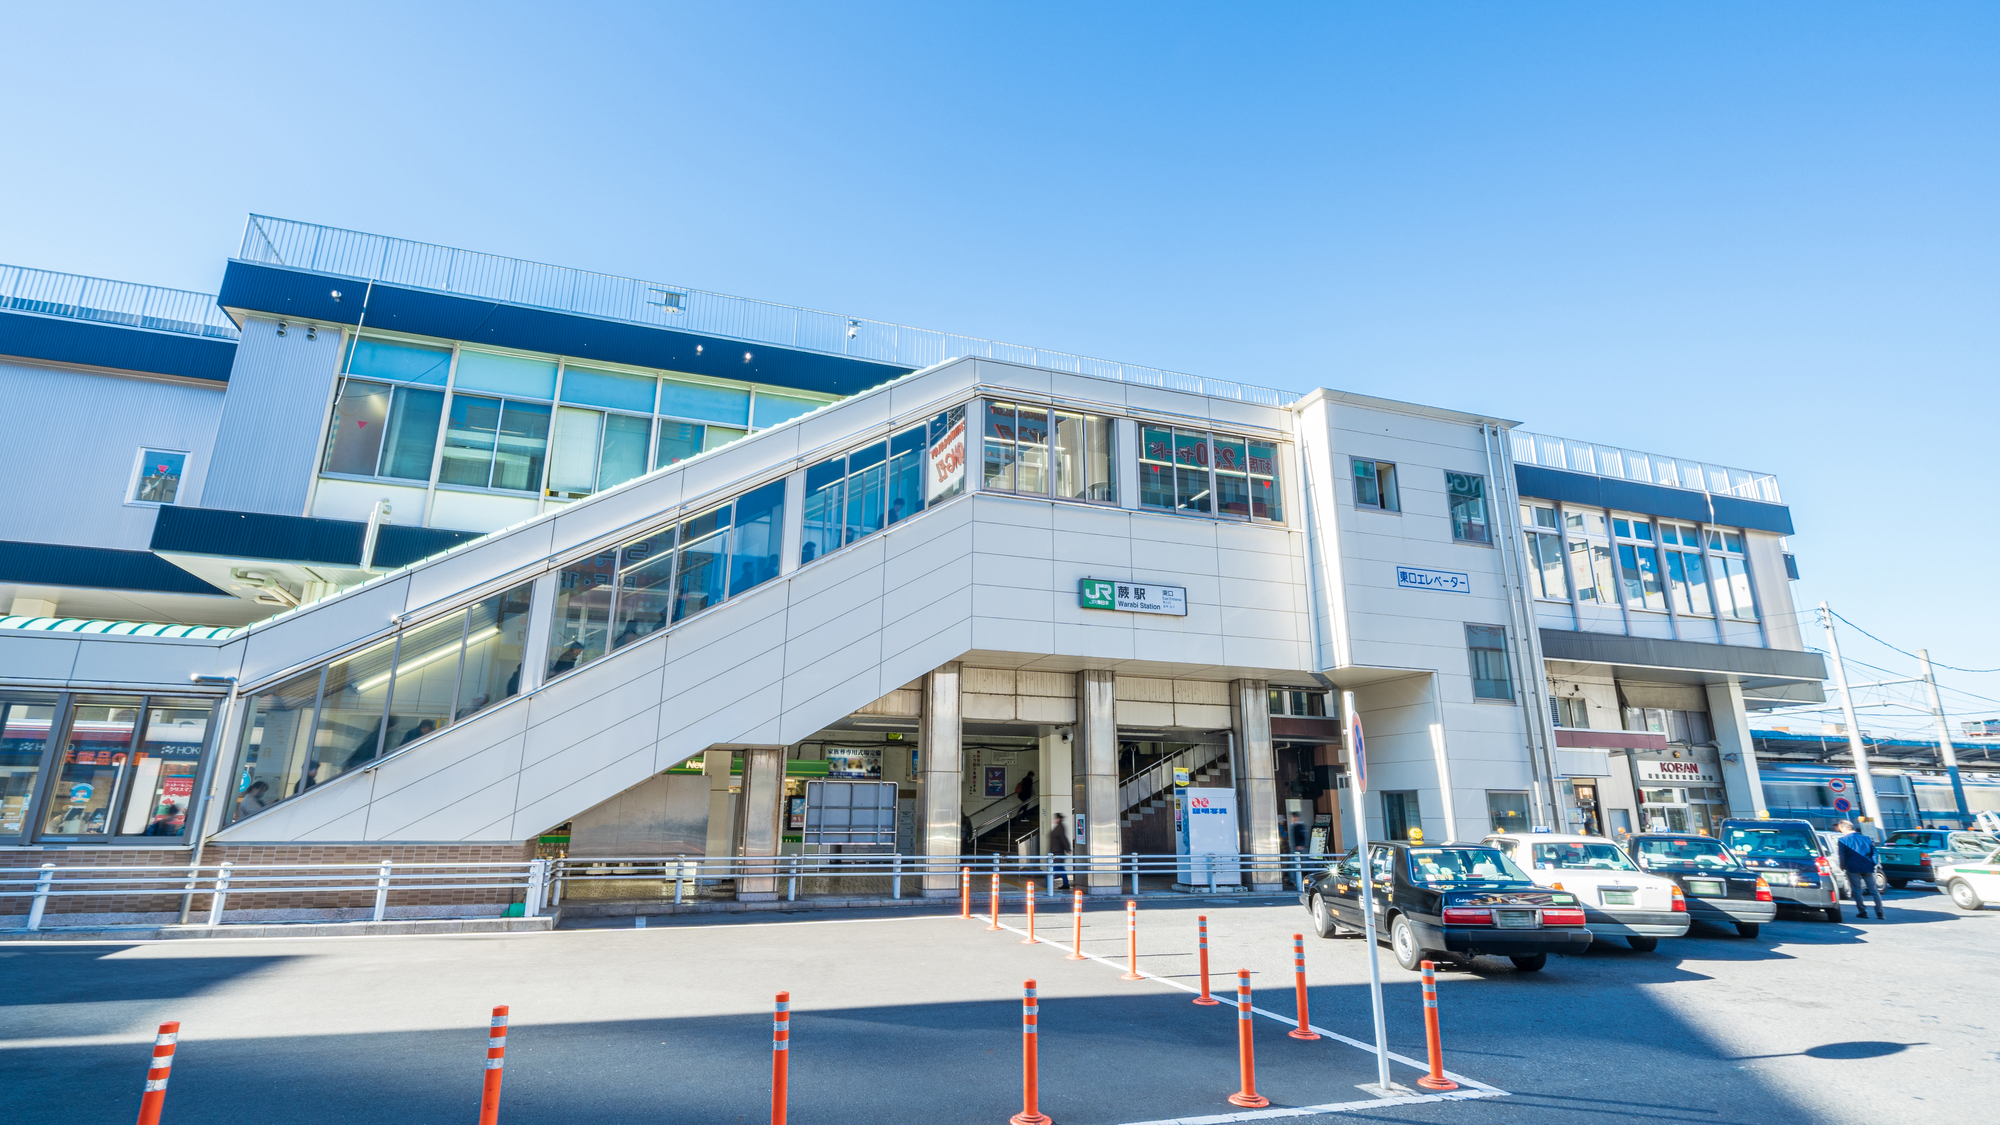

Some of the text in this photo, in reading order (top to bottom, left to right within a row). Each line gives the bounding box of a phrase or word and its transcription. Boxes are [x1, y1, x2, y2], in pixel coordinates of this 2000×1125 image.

[1399, 571, 1466, 588] 東口エレベーター
[1085, 583, 1112, 600] JR
[1117, 586, 1146, 600] 蕨駅
[1117, 600, 1139, 608] Warabi
[1139, 602, 1161, 610] Station
[1660, 762, 1699, 774] KOBAN
